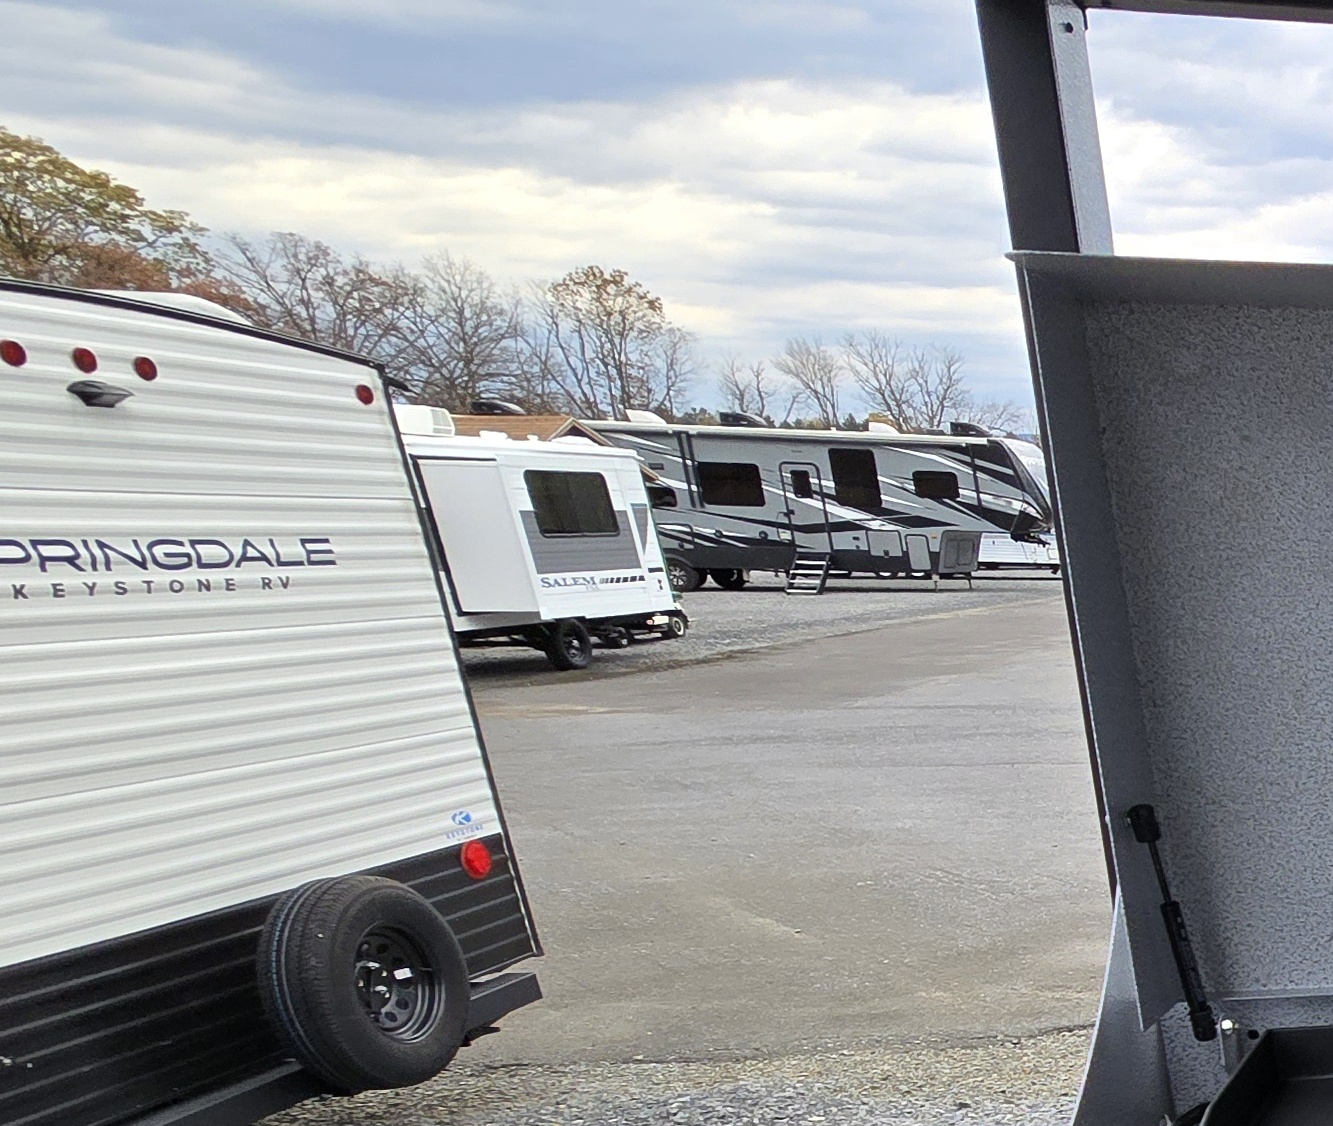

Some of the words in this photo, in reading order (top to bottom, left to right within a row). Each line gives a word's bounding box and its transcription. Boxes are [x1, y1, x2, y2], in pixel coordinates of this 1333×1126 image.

[11, 577, 236, 600] KEYSTONE
[261, 575, 291, 591] RV
[540, 576, 597, 589] SALEM
